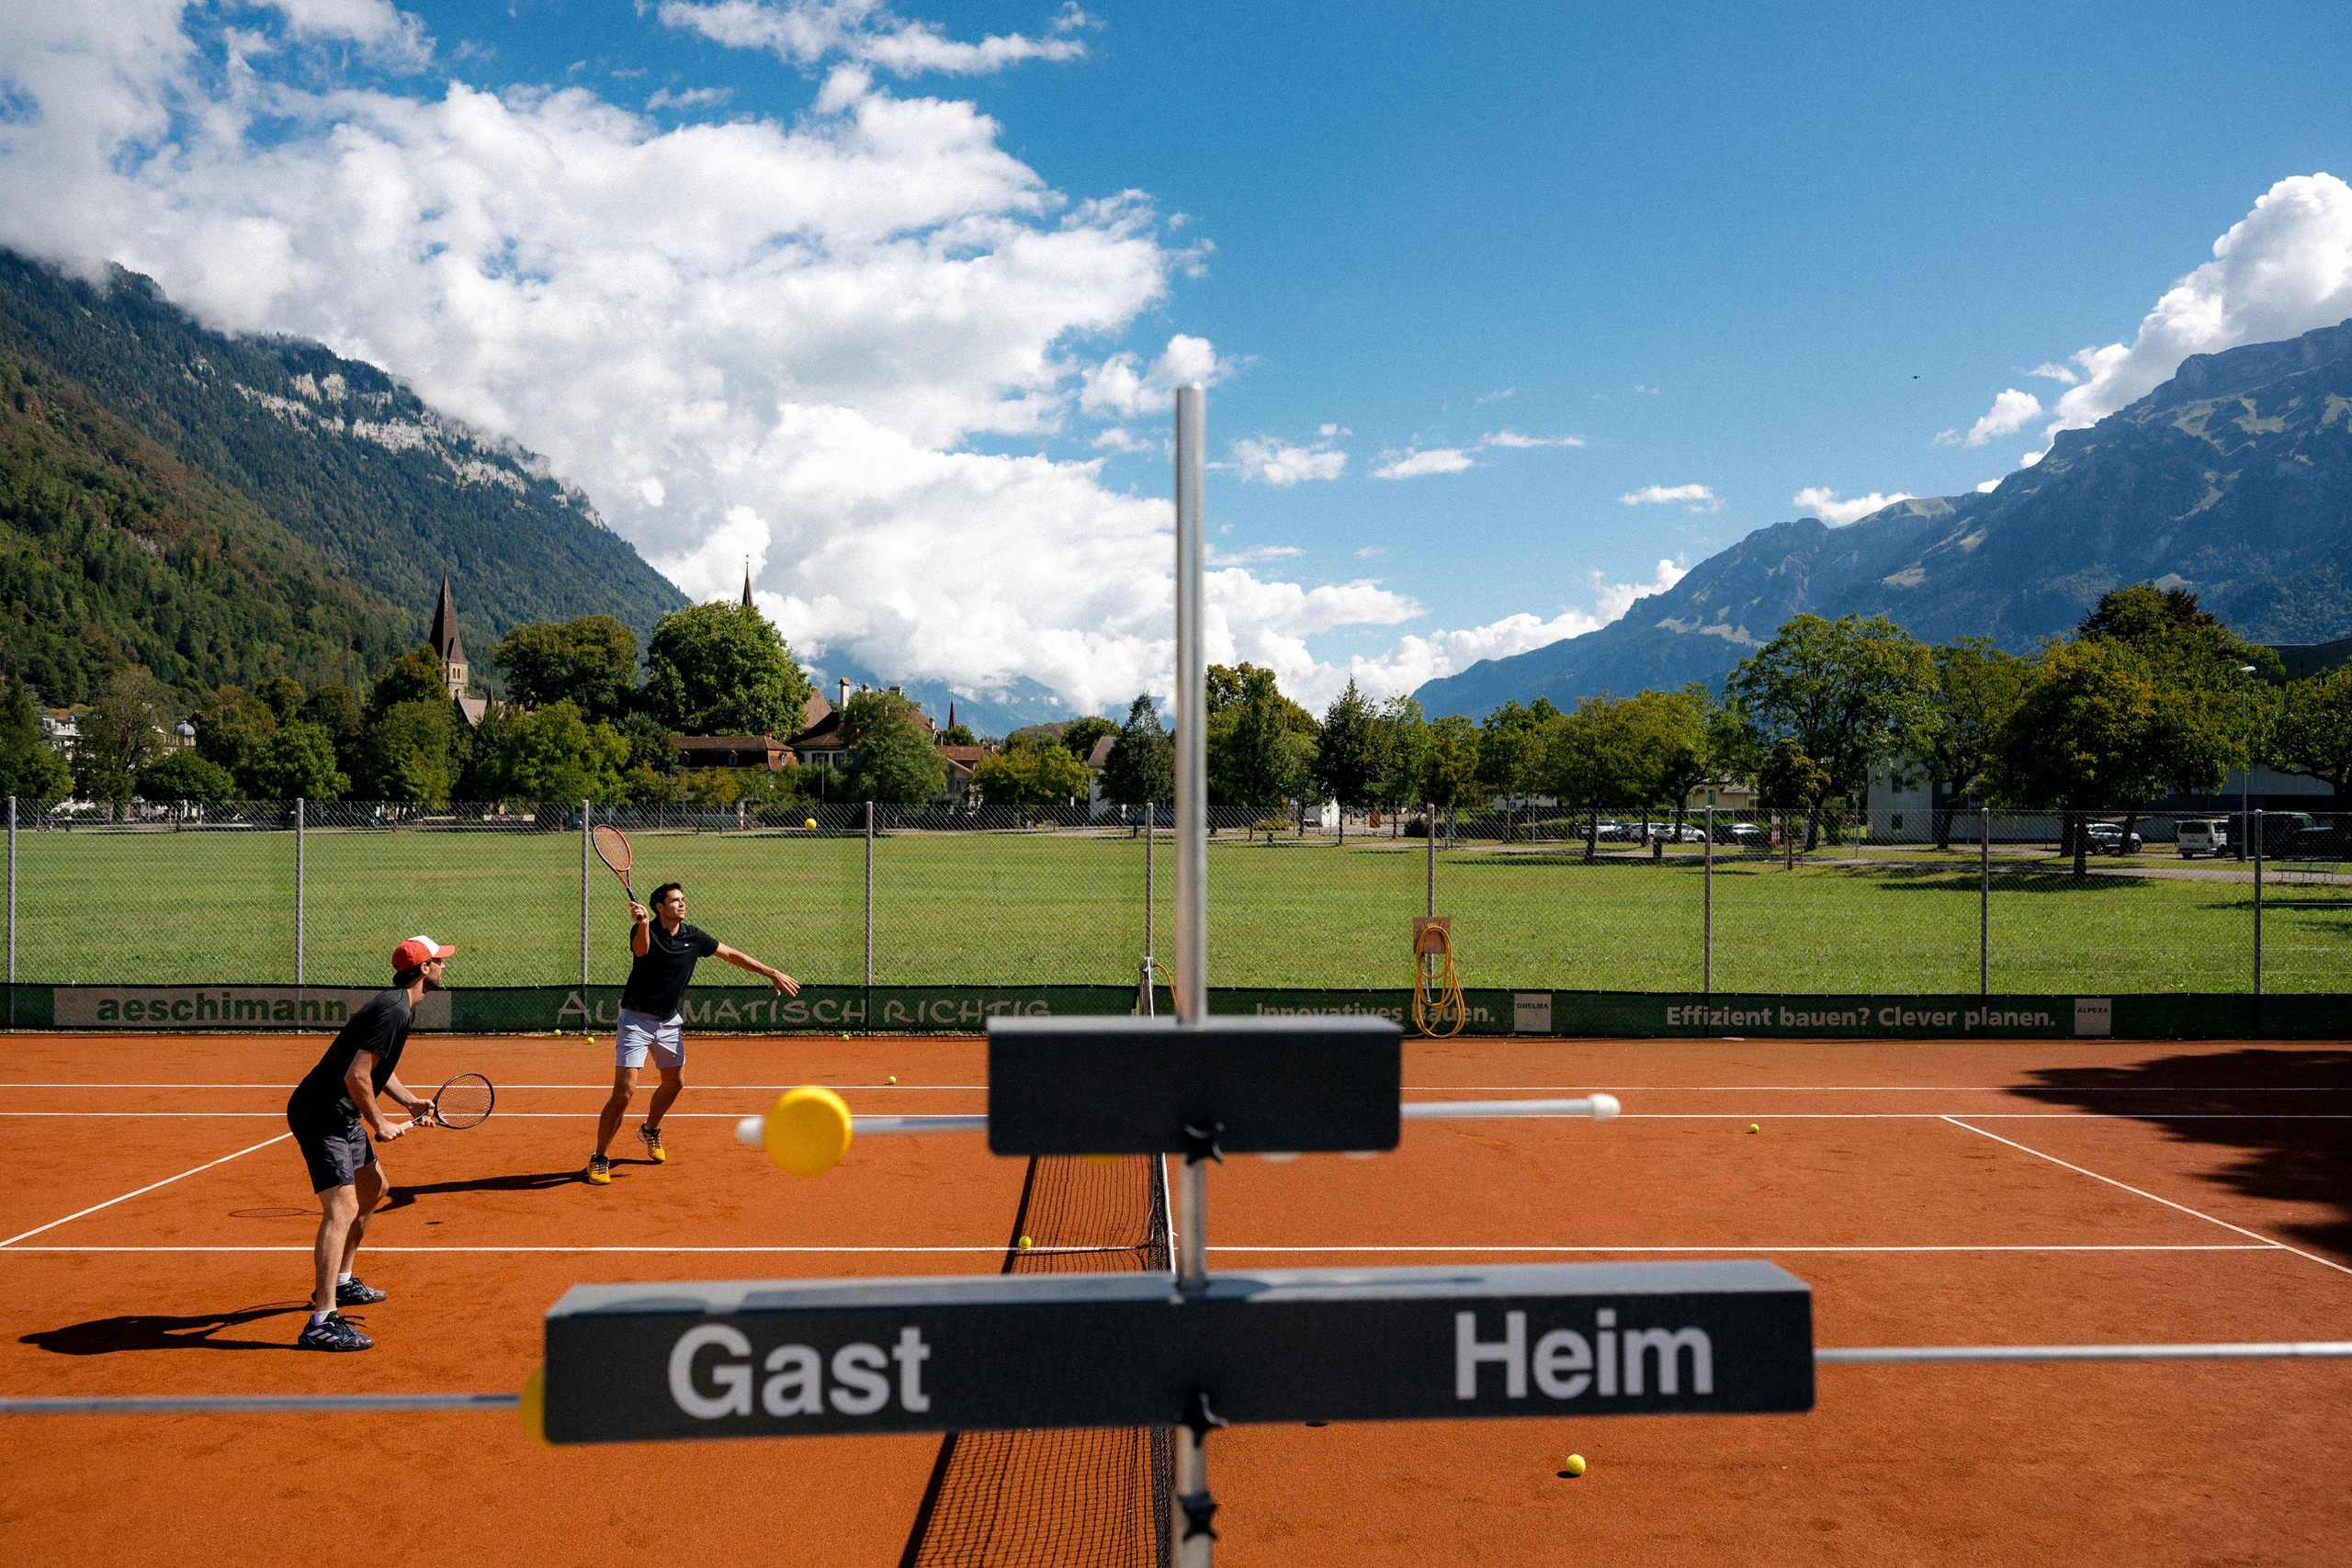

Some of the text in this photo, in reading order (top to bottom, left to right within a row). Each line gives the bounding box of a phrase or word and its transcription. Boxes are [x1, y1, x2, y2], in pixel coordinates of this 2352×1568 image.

[557, 991, 1052, 1024] AUMATISCH RICHTIG
[1411, 1003, 1496, 1022] Bauen.
[1667, 1006, 2056, 1032] Effizient bauen? Clever planen.
[667, 1310, 1714, 1420] Gast Heim
